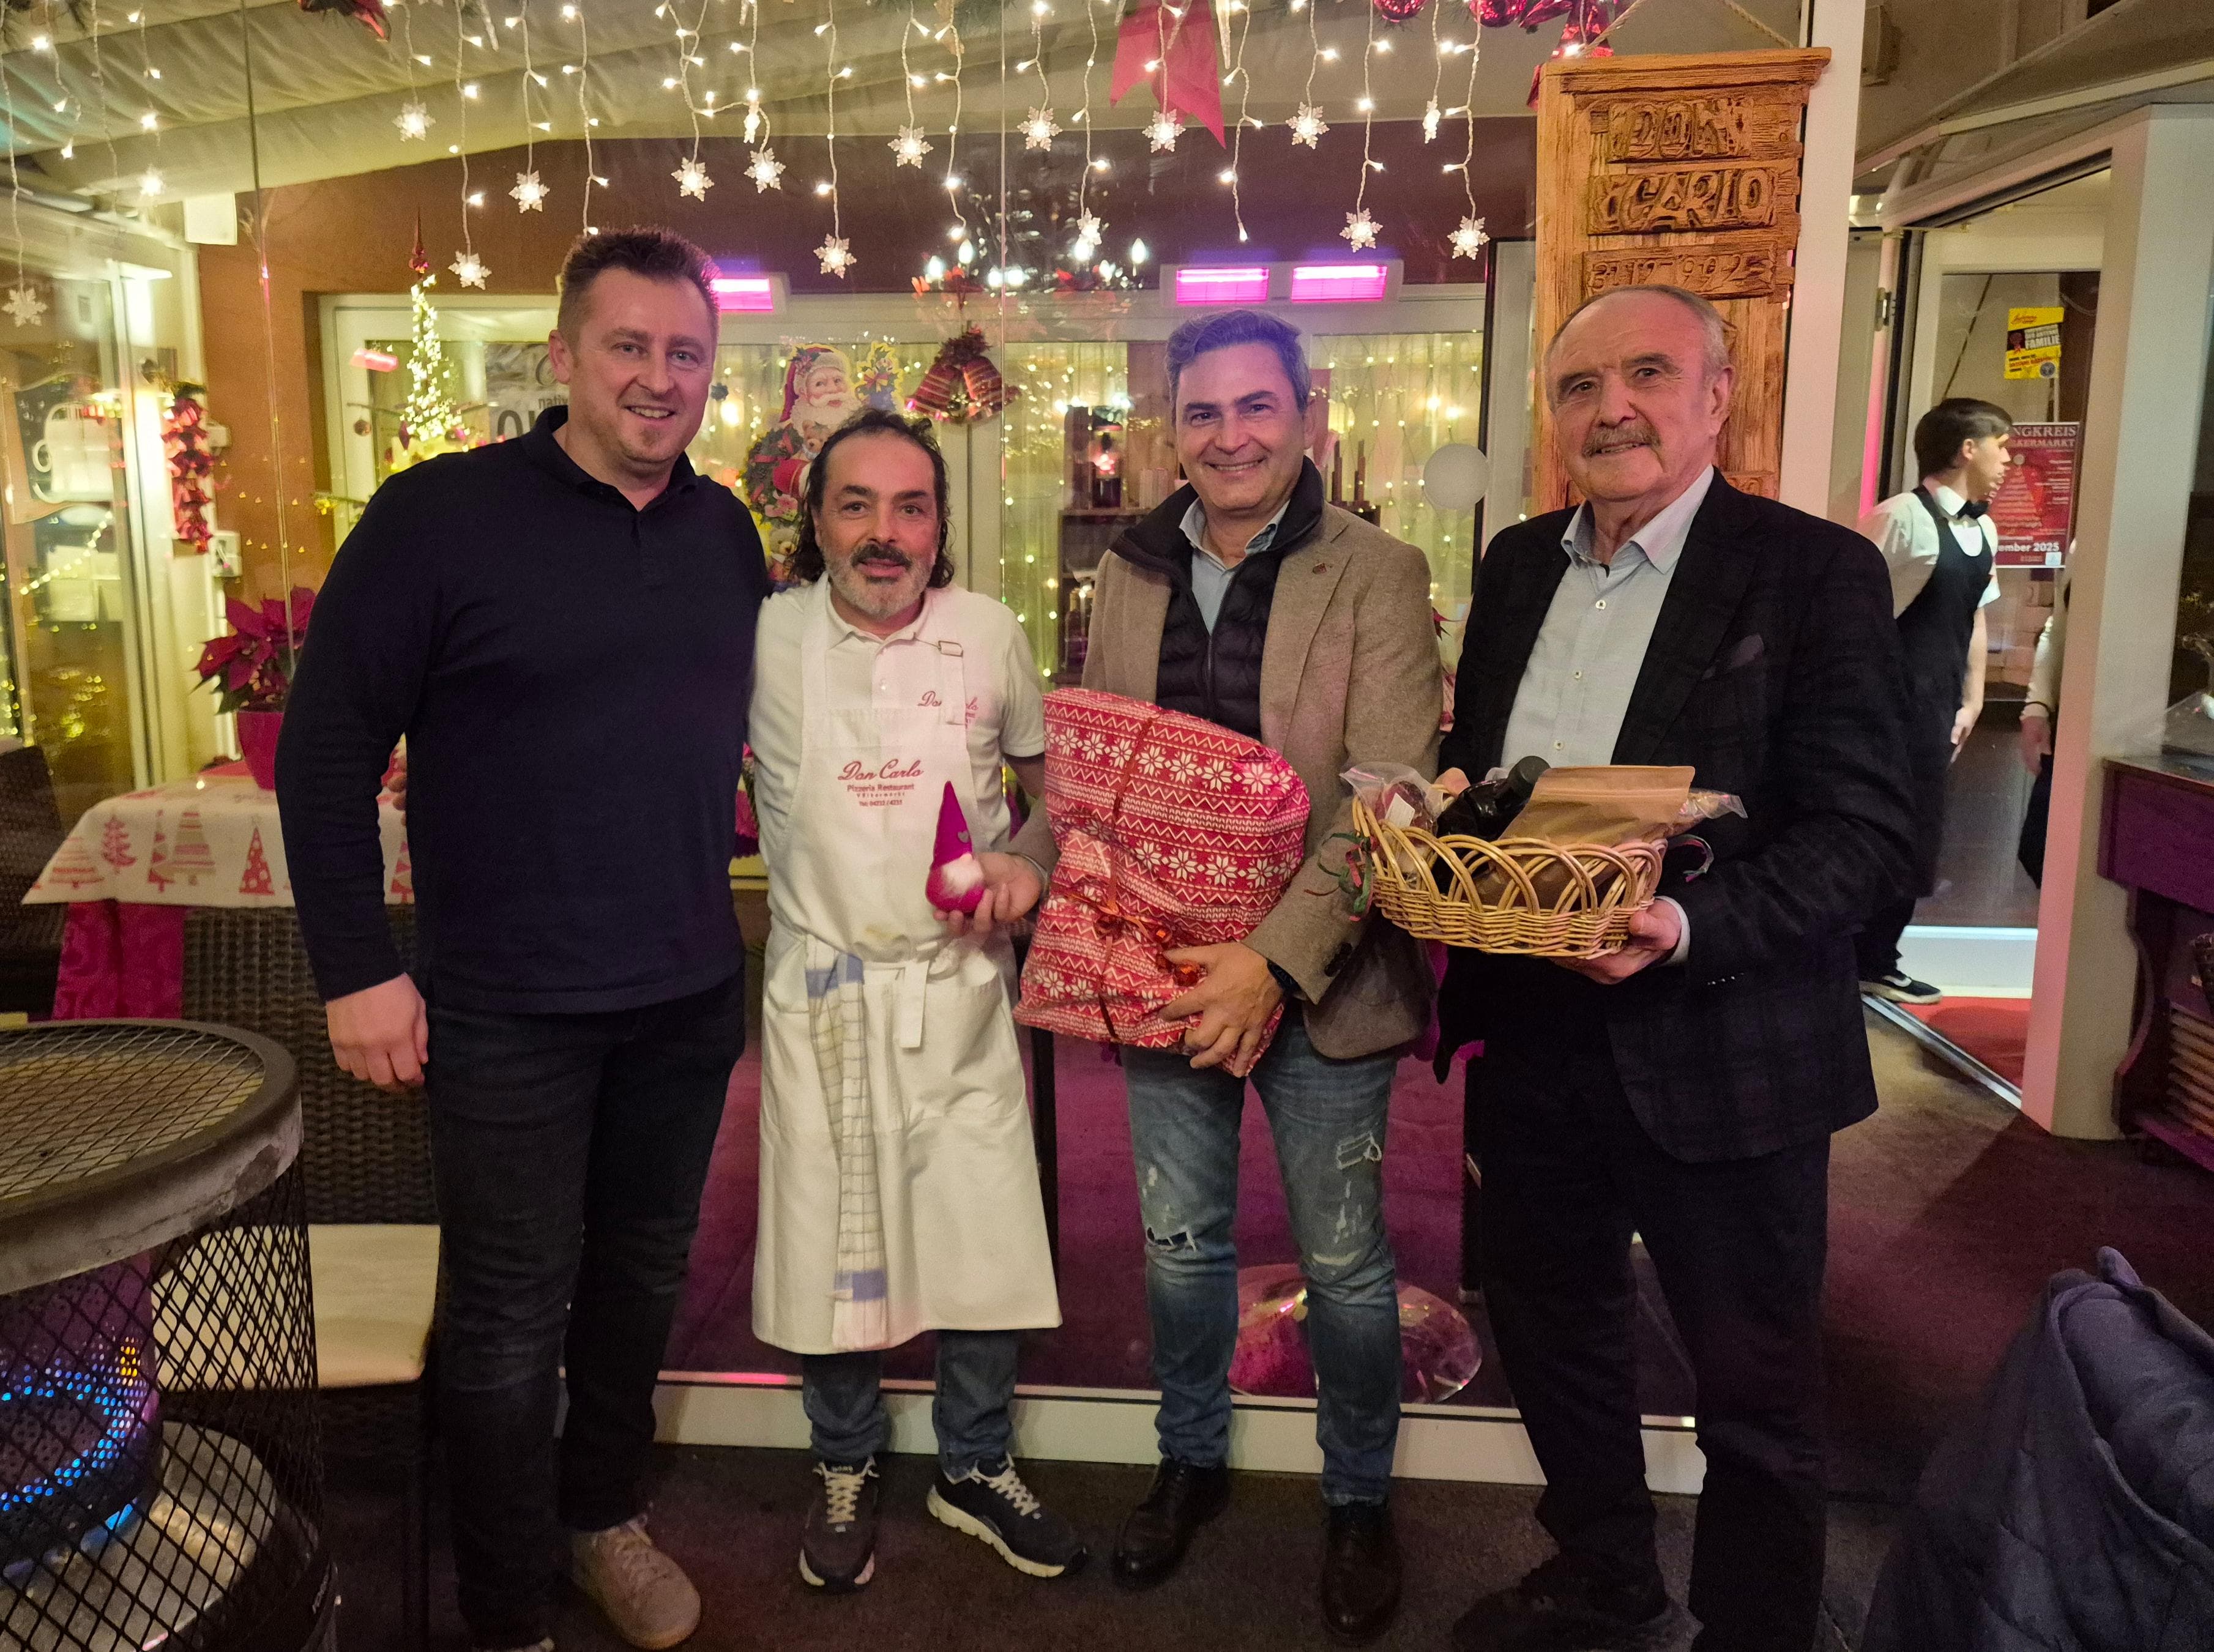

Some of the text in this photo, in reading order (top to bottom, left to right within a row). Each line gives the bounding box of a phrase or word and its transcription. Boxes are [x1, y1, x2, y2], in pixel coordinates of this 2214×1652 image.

[2025, 335, 2060, 350] FAMILIE
[2013, 426, 2076, 437] NGKREIS
[2018, 439, 2076, 447] KERMARKT
[1998, 541, 2060, 552] ember 2025
[837, 758, 924, 780] Don Carlo
